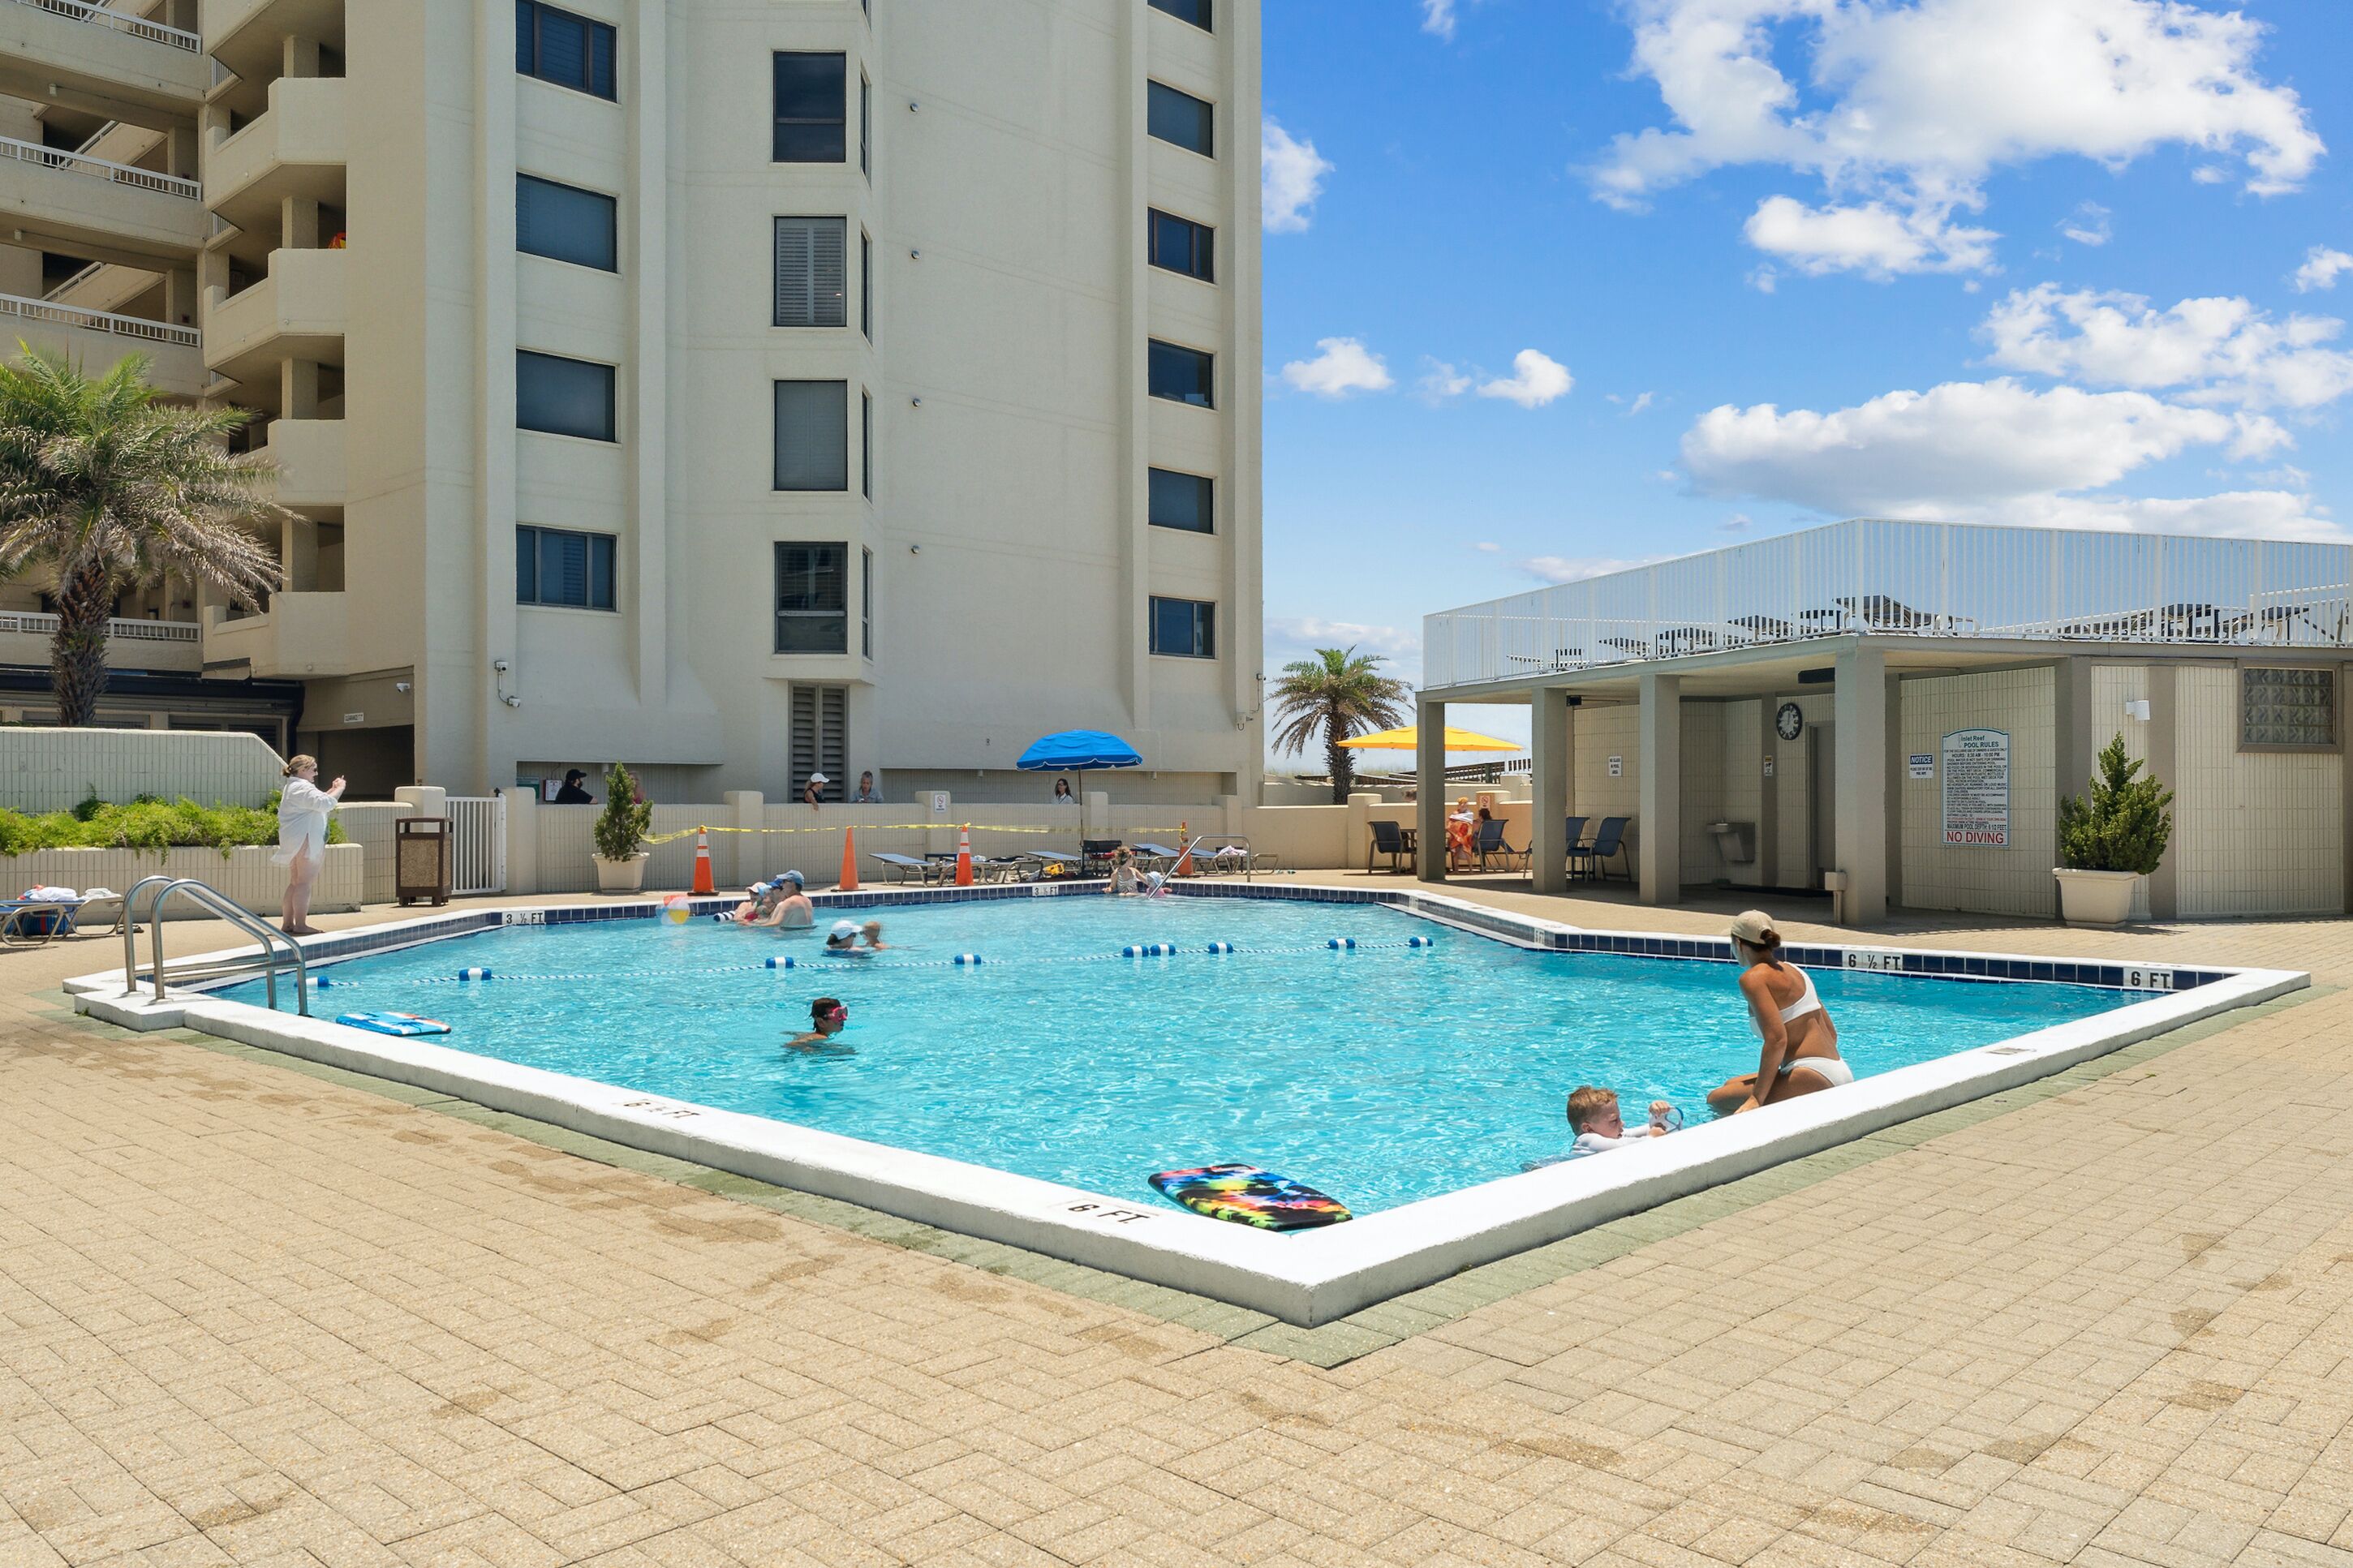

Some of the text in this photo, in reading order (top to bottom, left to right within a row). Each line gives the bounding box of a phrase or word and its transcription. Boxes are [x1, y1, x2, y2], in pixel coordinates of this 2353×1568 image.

[1947, 832, 2003, 843] NO DIVING
[507, 914, 512, 924] 3
[1849, 954, 1856, 967] 6
[1884, 956, 1901, 970] FT.
[2131, 971, 2170, 988] 6 FT.
